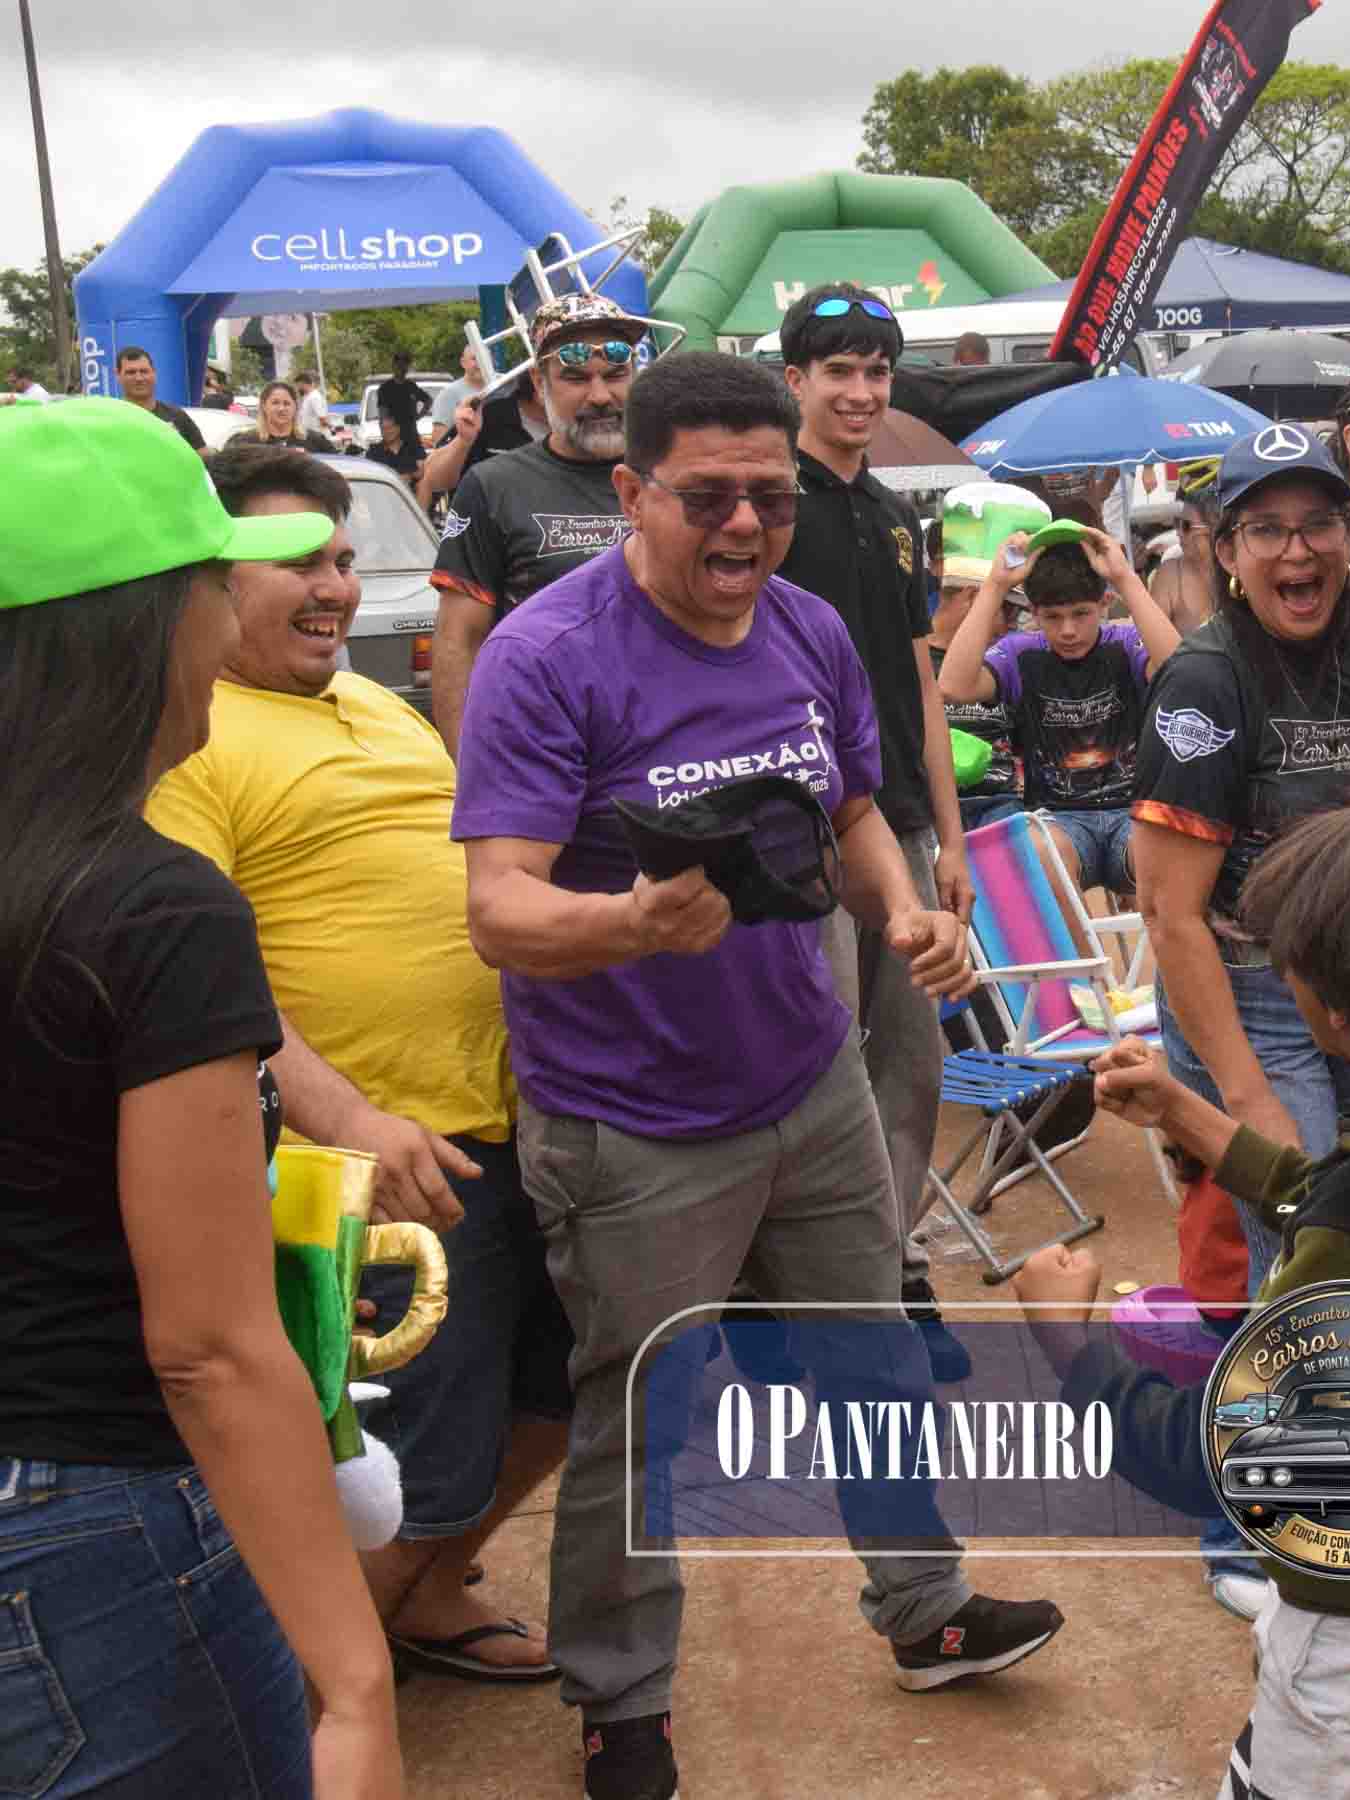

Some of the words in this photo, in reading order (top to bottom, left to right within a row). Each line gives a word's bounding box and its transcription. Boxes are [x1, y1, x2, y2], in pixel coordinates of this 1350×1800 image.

[1123, 306, 1137, 330] 67
[1189, 421, 1236, 437] TIM
[648, 740, 820, 786] CONEXÃO
[808, 779, 829, 793] 2025
